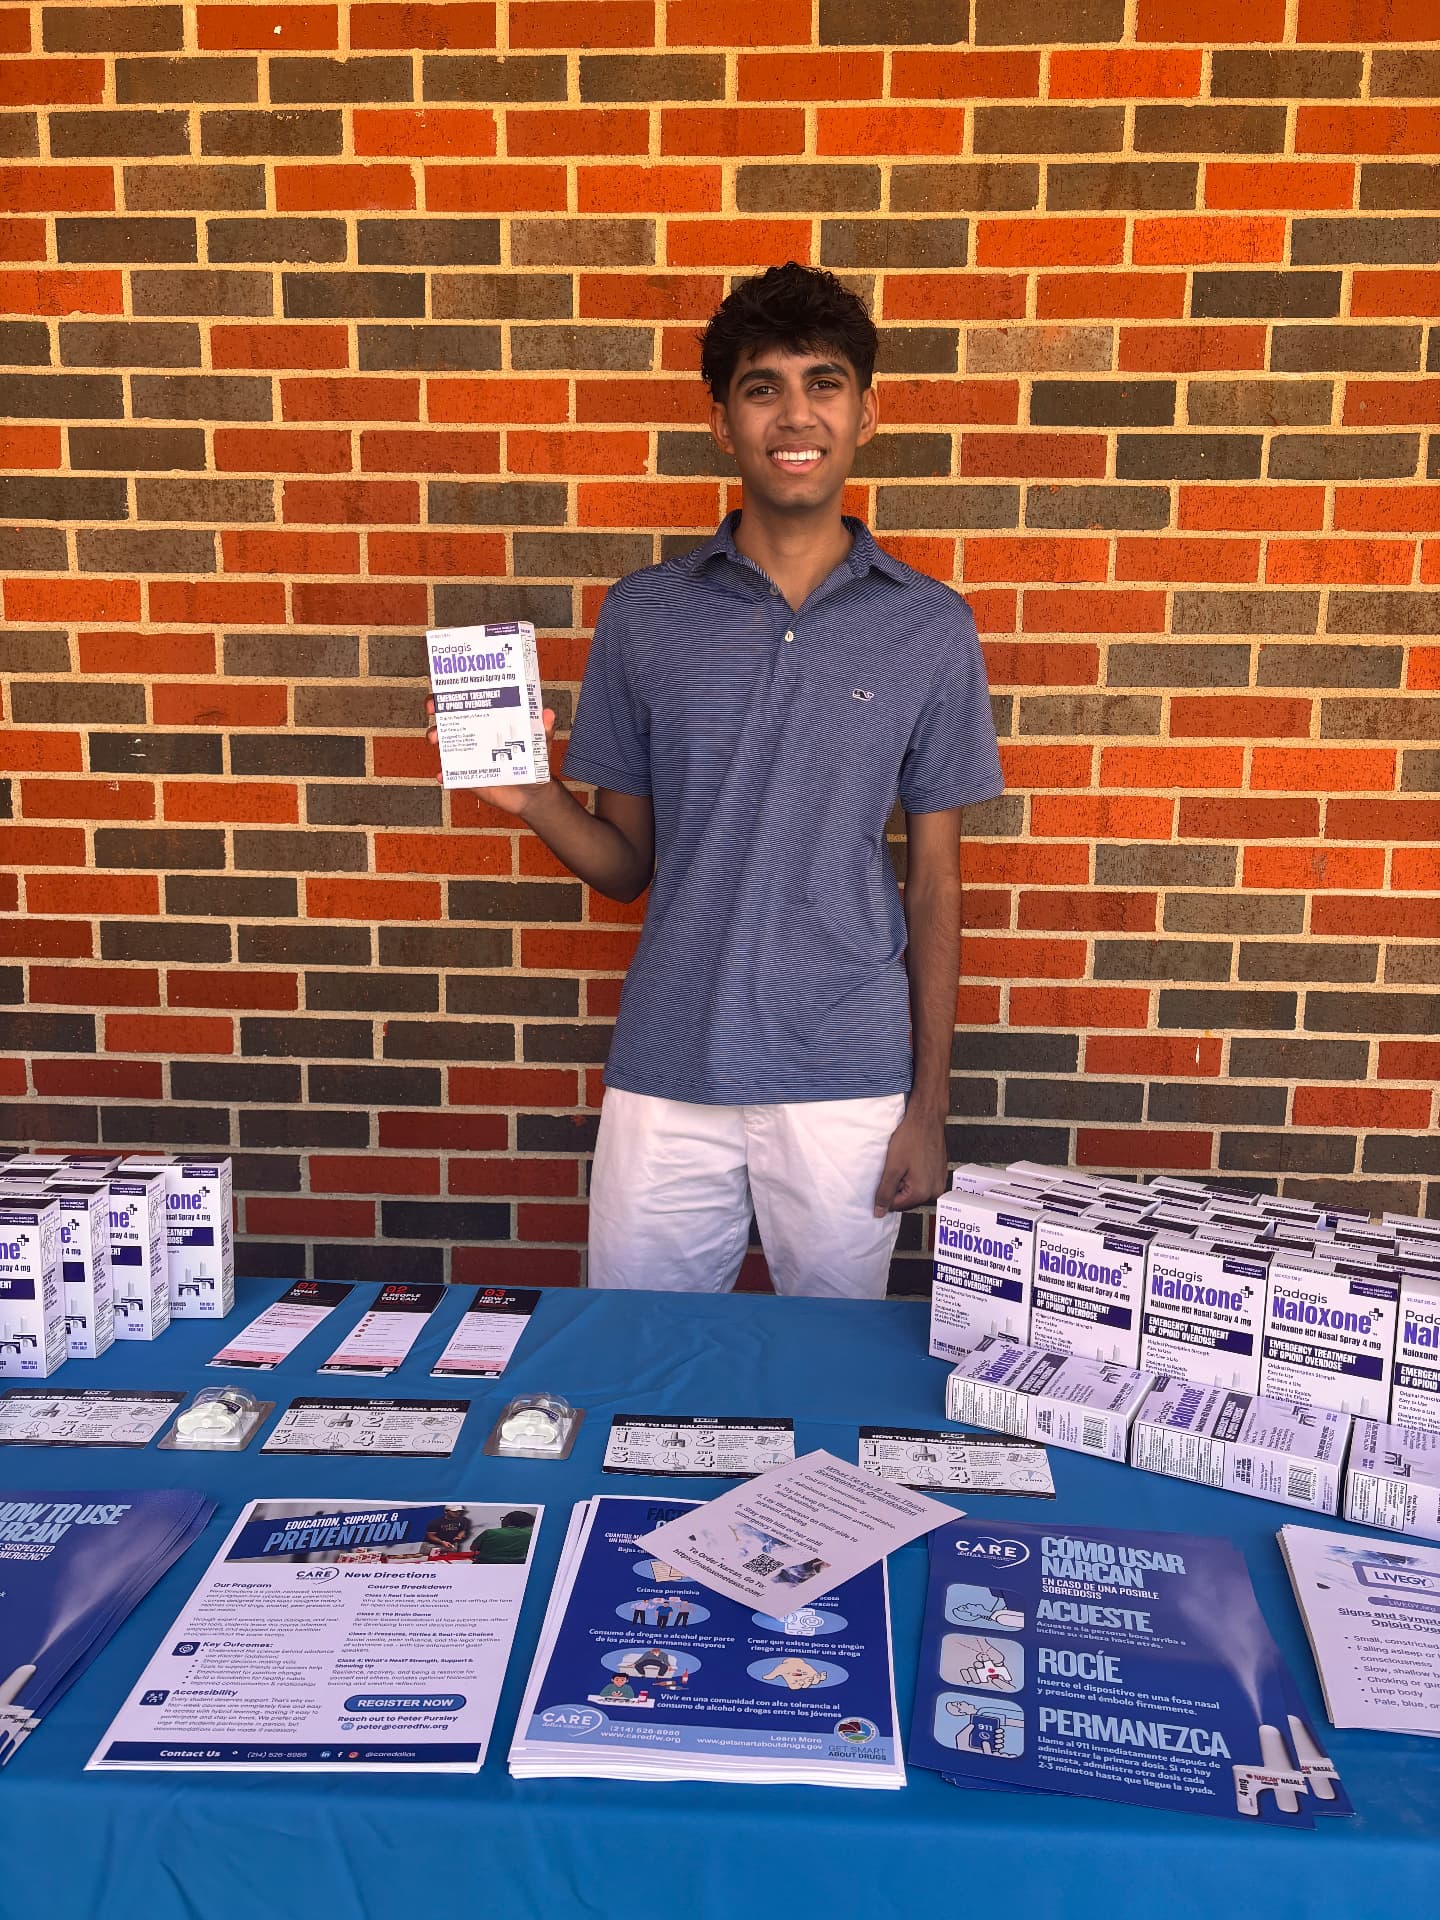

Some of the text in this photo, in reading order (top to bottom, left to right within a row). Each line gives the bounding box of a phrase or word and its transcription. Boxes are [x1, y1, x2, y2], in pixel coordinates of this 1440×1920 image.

[432, 643, 471, 654] Padagis
[433, 652, 506, 675] Naloxone
[940, 1216, 980, 1232] Padagis
[939, 1225, 1014, 1261] Naloxone
[1040, 1240, 1085, 1258] Padagis
[1040, 1250, 1122, 1287] Naloxone
[1153, 1264, 1203, 1282] Padagis
[1152, 1275, 1242, 1311] Naloxone
[1273, 1285, 1328, 1304] Padagis
[1272, 1296, 1372, 1335] Naloxone
[1148, 1325, 1216, 1346] OF OPIOID OVERDOSE
[1149, 1316, 1229, 1340] EMERGENCY TREATMENT
[1271, 1322, 1303, 1335] Naloxone
[1318, 1329, 1338, 1341] Nasal
[1340, 1335, 1361, 1347] Spray
[1369, 1341, 1381, 1350] mg
[1268, 1349, 1343, 1371] OF OPIOID OVERDOSE
[1270, 1339, 1357, 1365] EMERGENCY TREATMENT
[1403, 1348, 1438, 1361] Naloxone
[977, 1346, 1024, 1383] Naloxone
[1401, 1376, 1437, 1390] OF OPIOID
[1166, 1387, 1205, 1429] Naloxone
[43, 1504, 82, 1523] TO
[75, 1505, 132, 1524] USE
[285, 1513, 398, 1530] EDUCATION, SUPPORT, &
[262, 1521, 409, 1552] PREVENTION
[2, 1544, 55, 1553] SUSPECTED
[955, 1540, 1017, 1558] CARE
[1041, 1536, 1187, 1574] CÓMO USAR
[673, 1548, 765, 1597] https://naloxonetexas.com/
[698, 1552, 720, 1565] Order
[718, 1563, 742, 1579] Narcan,
[755, 1581, 766, 1589] To:
[1041, 1557, 1144, 1588] NARCAN
[1374, 1571, 1429, 1587] LIVEGY
[1042, 1578, 1160, 1600] EN CASO DE UNA POSIBLE
[1042, 1585, 1102, 1600] SOBREDOSIS
[1035, 1599, 1153, 1633] ACUESTE
[1338, 1607, 1400, 1620] Signs and
[1371, 1619, 1411, 1630] Opioid
[1354, 1635, 1440, 1650] Small, constricted
[1038, 1648, 1123, 1684] ROCÍE
[1360, 1656, 1433, 1668] consciousness
[1367, 1676, 1409, 1686] Choking
[173, 1689, 238, 1697] Accessibility
[1370, 1687, 1423, 1698] Limp body
[423, 1699, 454, 1707] NOW
[707, 1704, 735, 1712] alcohol
[744, 1706, 771, 1715] drogas
[811, 1709, 842, 1718] jóvenes
[710, 1696, 755, 1706] comunidad
[772, 1699, 789, 1707] alta
[791, 1700, 830, 1710] tolerancia
[356, 1723, 449, 1731] peter@caredfw.org
[423, 1715, 458, 1723] Pursley
[542, 1713, 592, 1725] CARE
[978, 1723, 992, 1731] 911
[600, 1731, 681, 1743] www.caredfw.org
[610, 1726, 634, 1734] (214)
[1039, 1706, 1232, 1759] PERMANEZCA
[697, 1738, 823, 1750] www.getsmartaboutdrugs.gov
[850, 1746, 887, 1754] SMART
[1037, 1736, 1064, 1746] Llame
[1076, 1742, 1090, 1750] 911
[1092, 1744, 1168, 1762] inmediatamente
[1170, 1756, 1207, 1767] después
[1209, 1761, 1221, 1769] de
[160, 1750, 220, 1758] Contact Us
[1037, 1745, 1091, 1758] administrar
[1093, 1753, 1102, 1761] la
[1104, 1755, 1139, 1768] primera
[1141, 1760, 1167, 1771] dosis.
[1169, 1764, 1178, 1772] Si
[1194, 1768, 1211, 1778] hay
[1038, 1761, 1216, 1796] 2-3 minutos hasta que llegue la ayuda.
[1083, 1759, 1133, 1774] administre
[1134, 1769, 1155, 1778] otra
[1157, 1771, 1181, 1782] dosis
[1183, 1775, 1205, 1785] cada
[1239, 1778, 1249, 1789] mg
